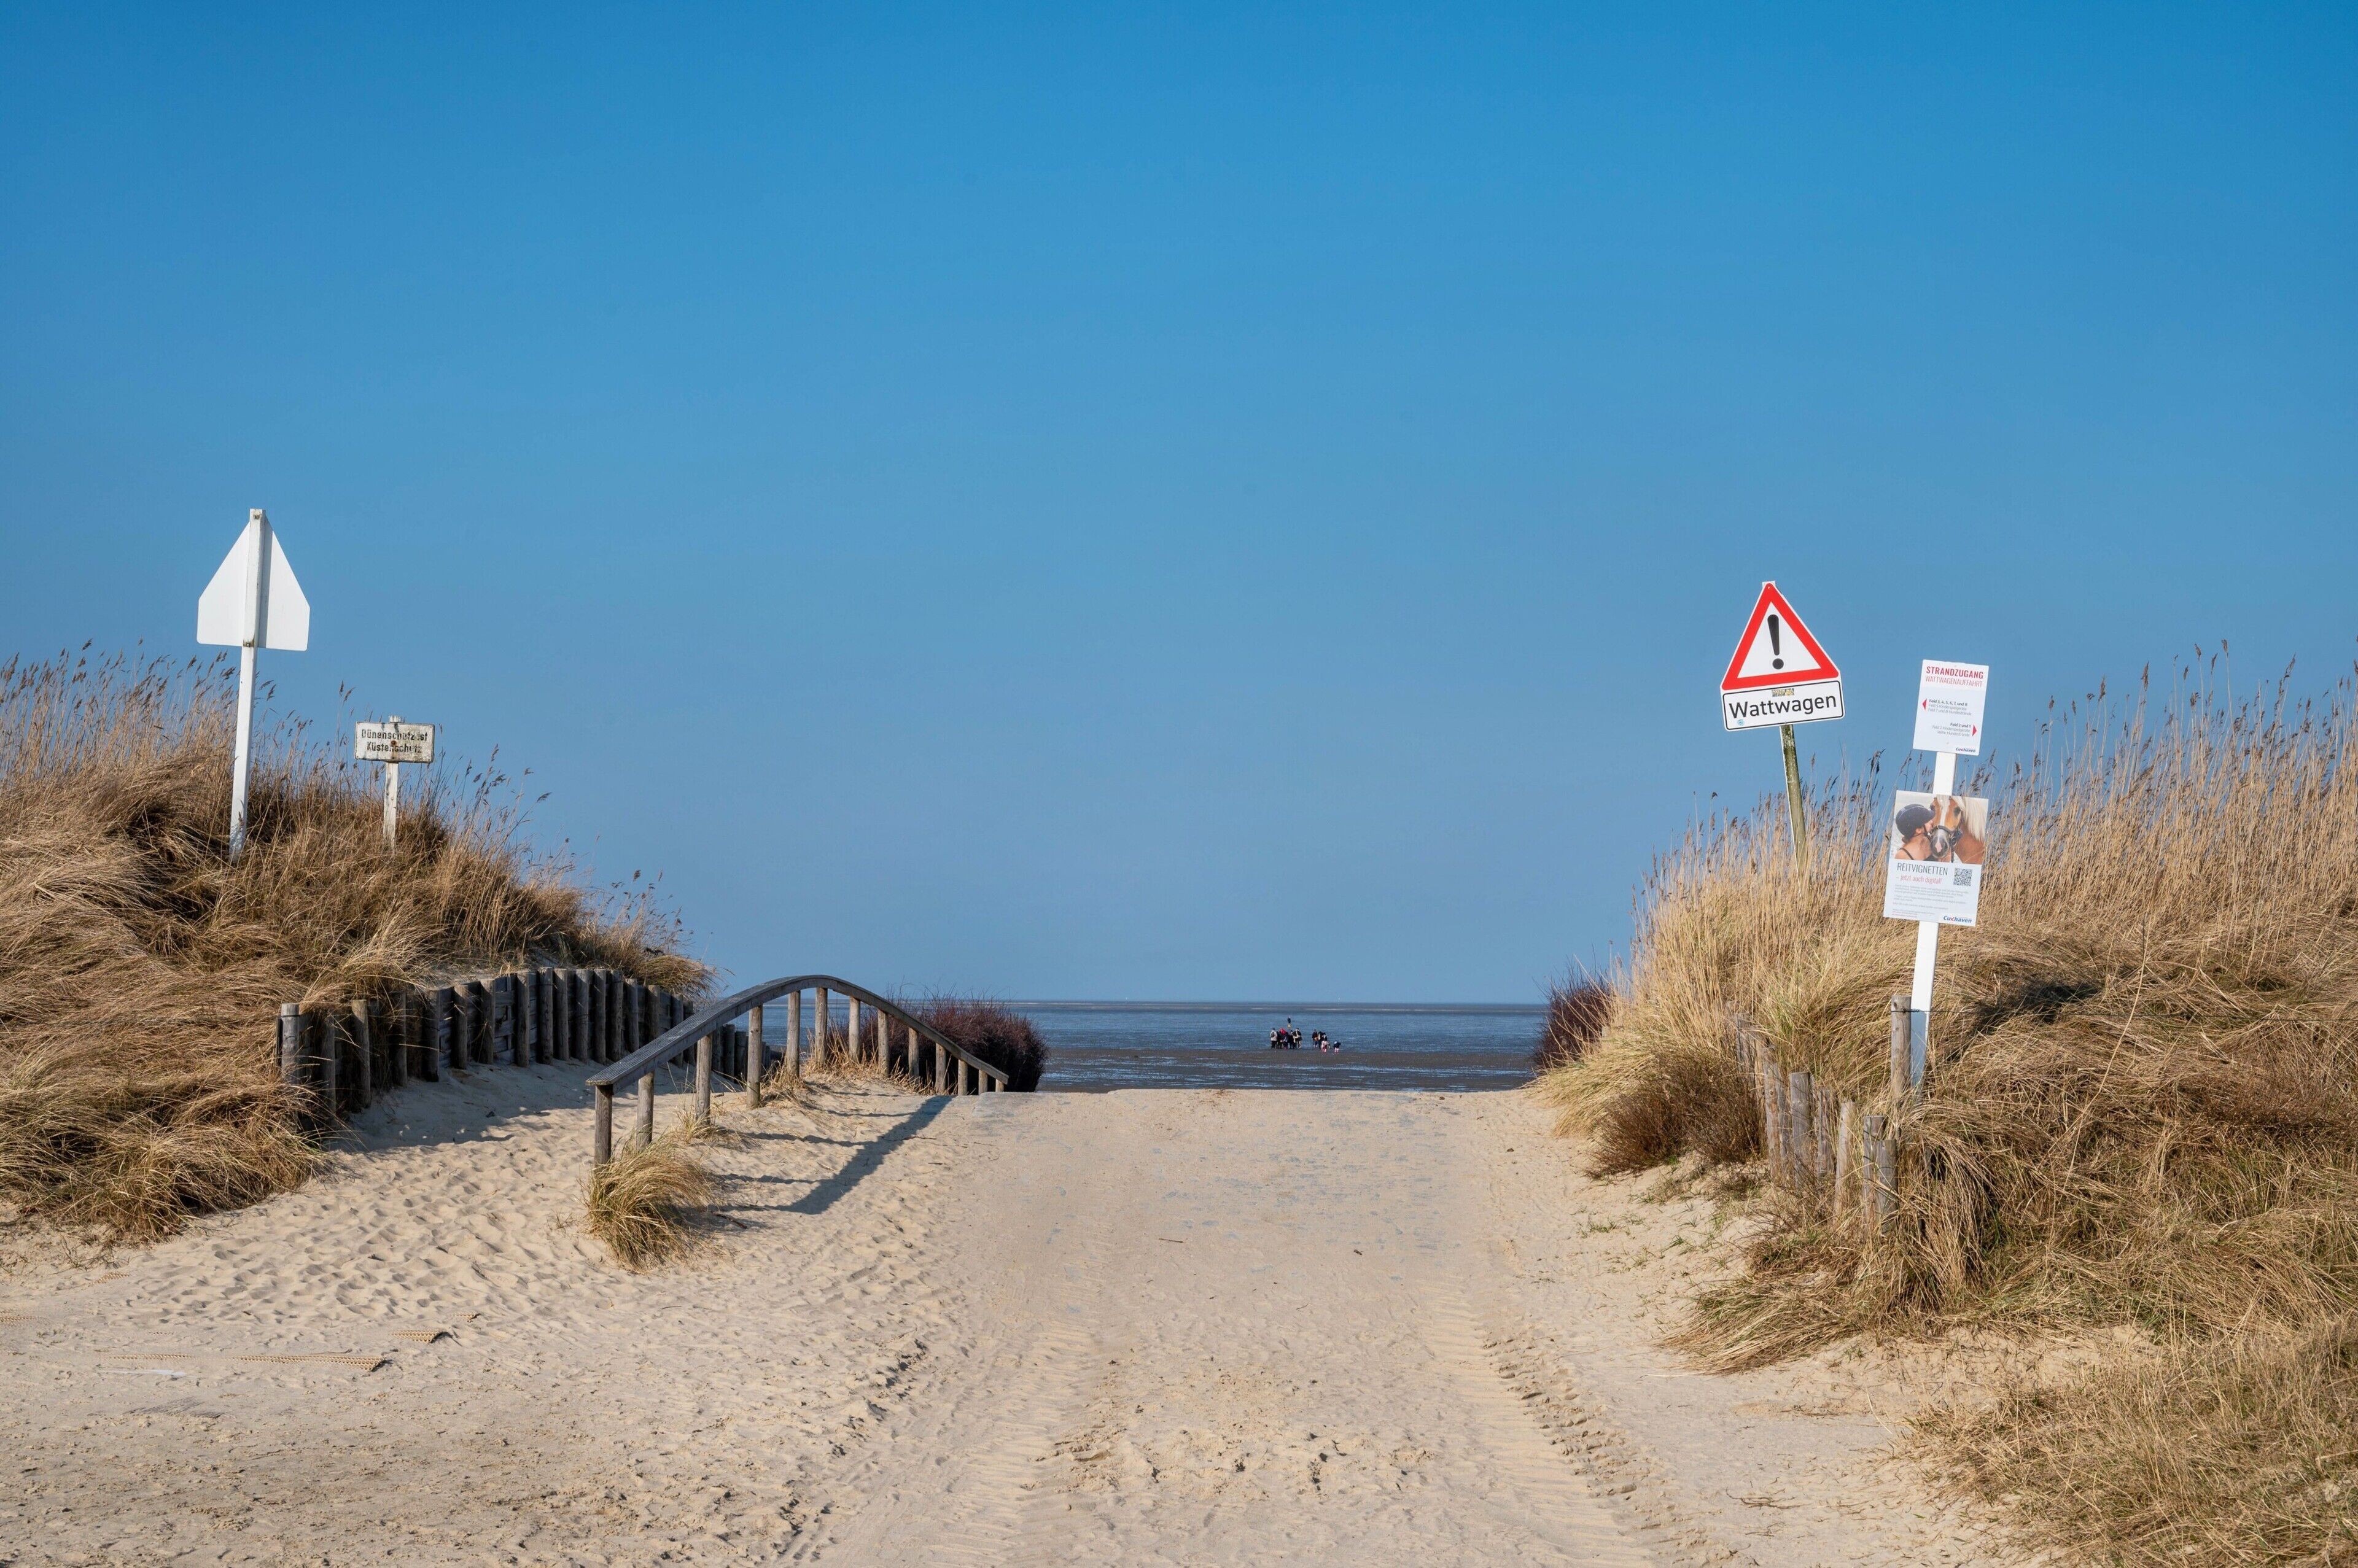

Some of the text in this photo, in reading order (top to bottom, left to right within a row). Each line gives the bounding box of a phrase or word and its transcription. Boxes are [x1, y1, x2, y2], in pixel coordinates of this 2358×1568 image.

[1926, 666, 1984, 679] STRANDZUGANG
[1925, 675, 1983, 687] WATTWAGENAUFFAHRT
[1729, 696, 1837, 718] Wattwagen
[362, 729, 428, 742] Dünenschutz ist
[1897, 863, 1948, 875] REITVIGNETTEN
